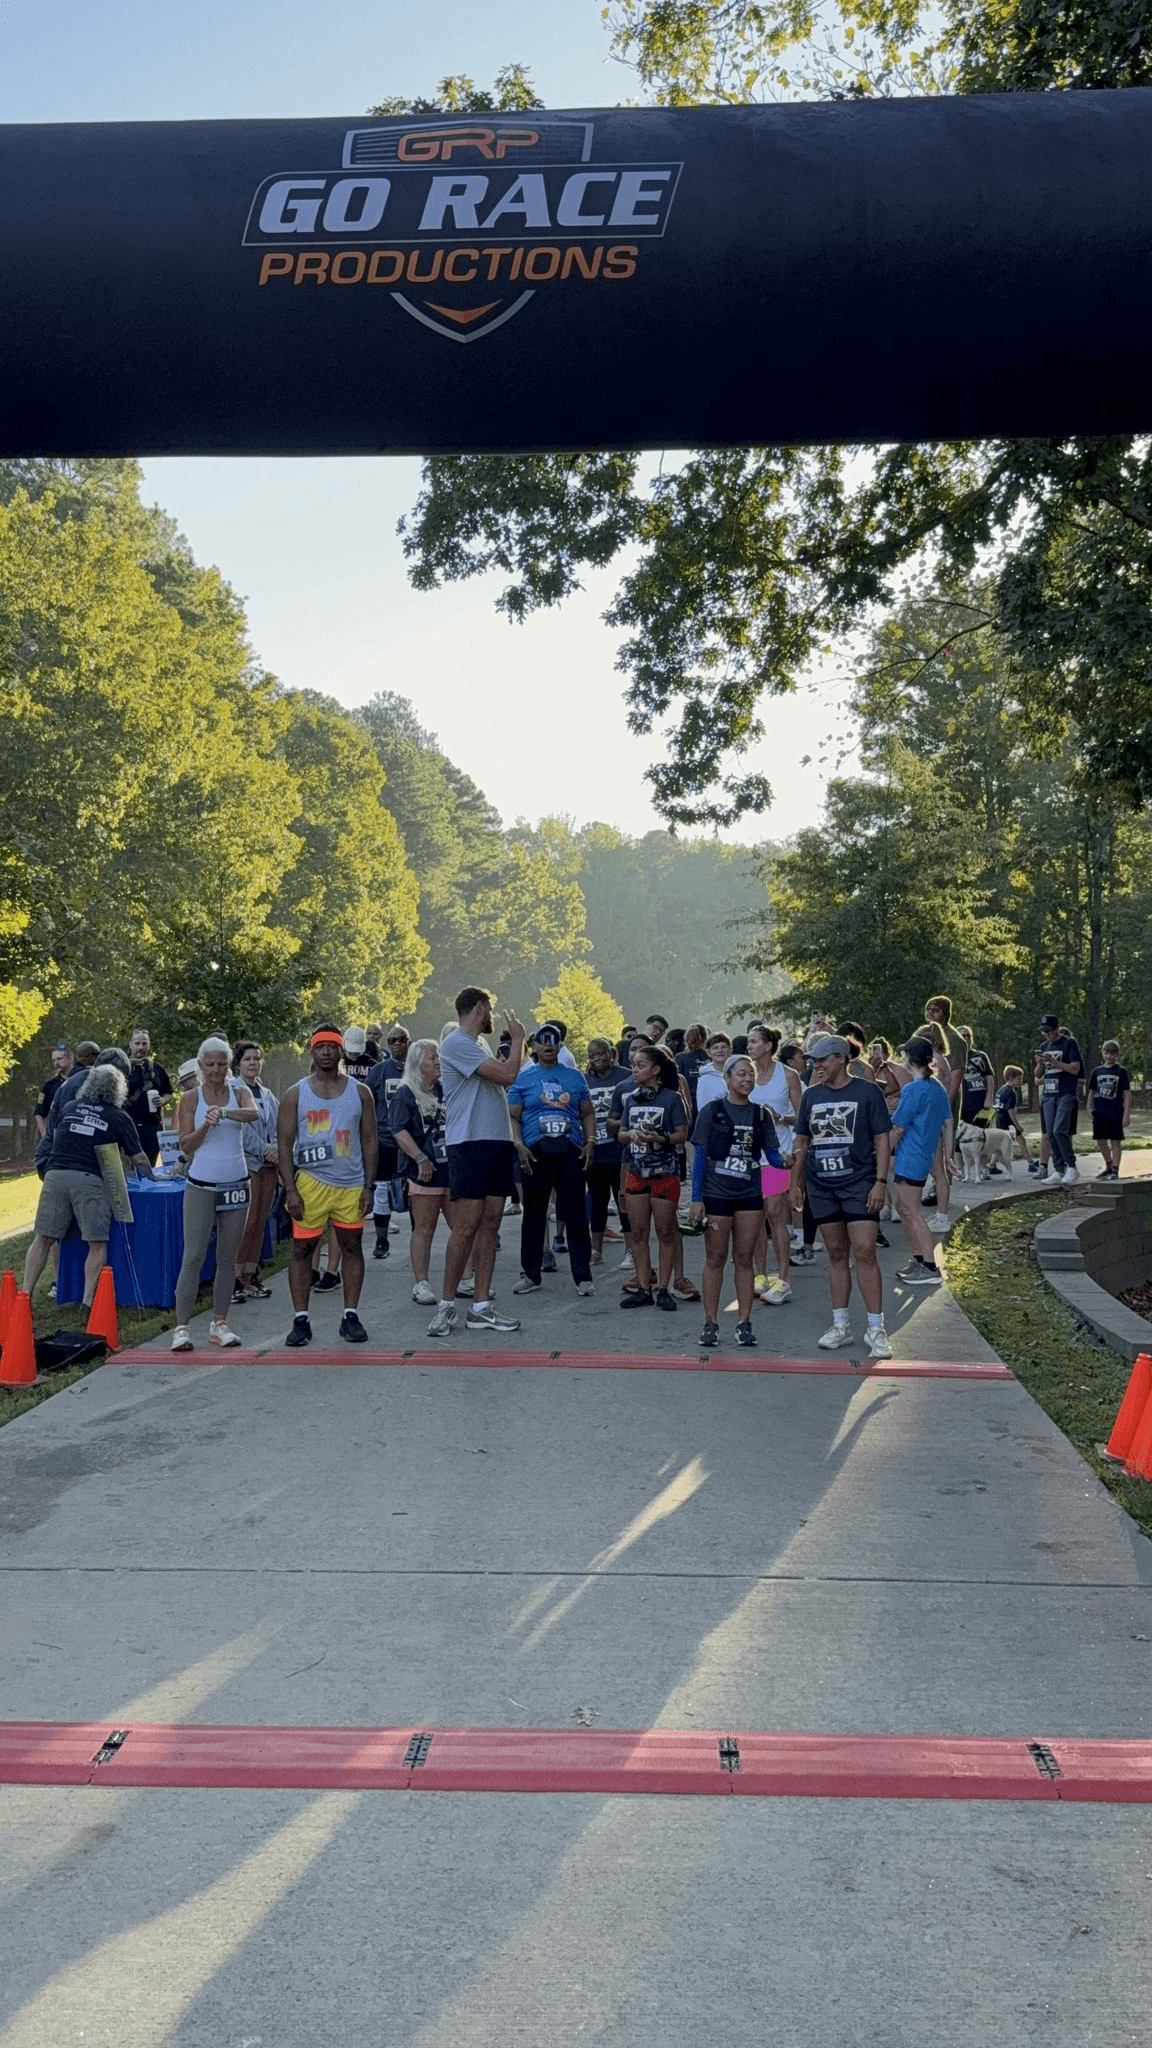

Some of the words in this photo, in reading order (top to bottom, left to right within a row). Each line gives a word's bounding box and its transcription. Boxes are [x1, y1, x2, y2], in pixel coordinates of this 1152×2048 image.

[398, 127, 540, 162] GRP
[258, 177, 392, 234] GO
[417, 170, 672, 231] RACE
[258, 245, 640, 286] PRODUCTIONS
[545, 1121, 567, 1133] 157
[594, 1128, 608, 1140] 35
[303, 1146, 327, 1163] 118
[724, 1156, 748, 1173] 129
[820, 1156, 845, 1171] 151
[223, 1189, 247, 1205] 109
